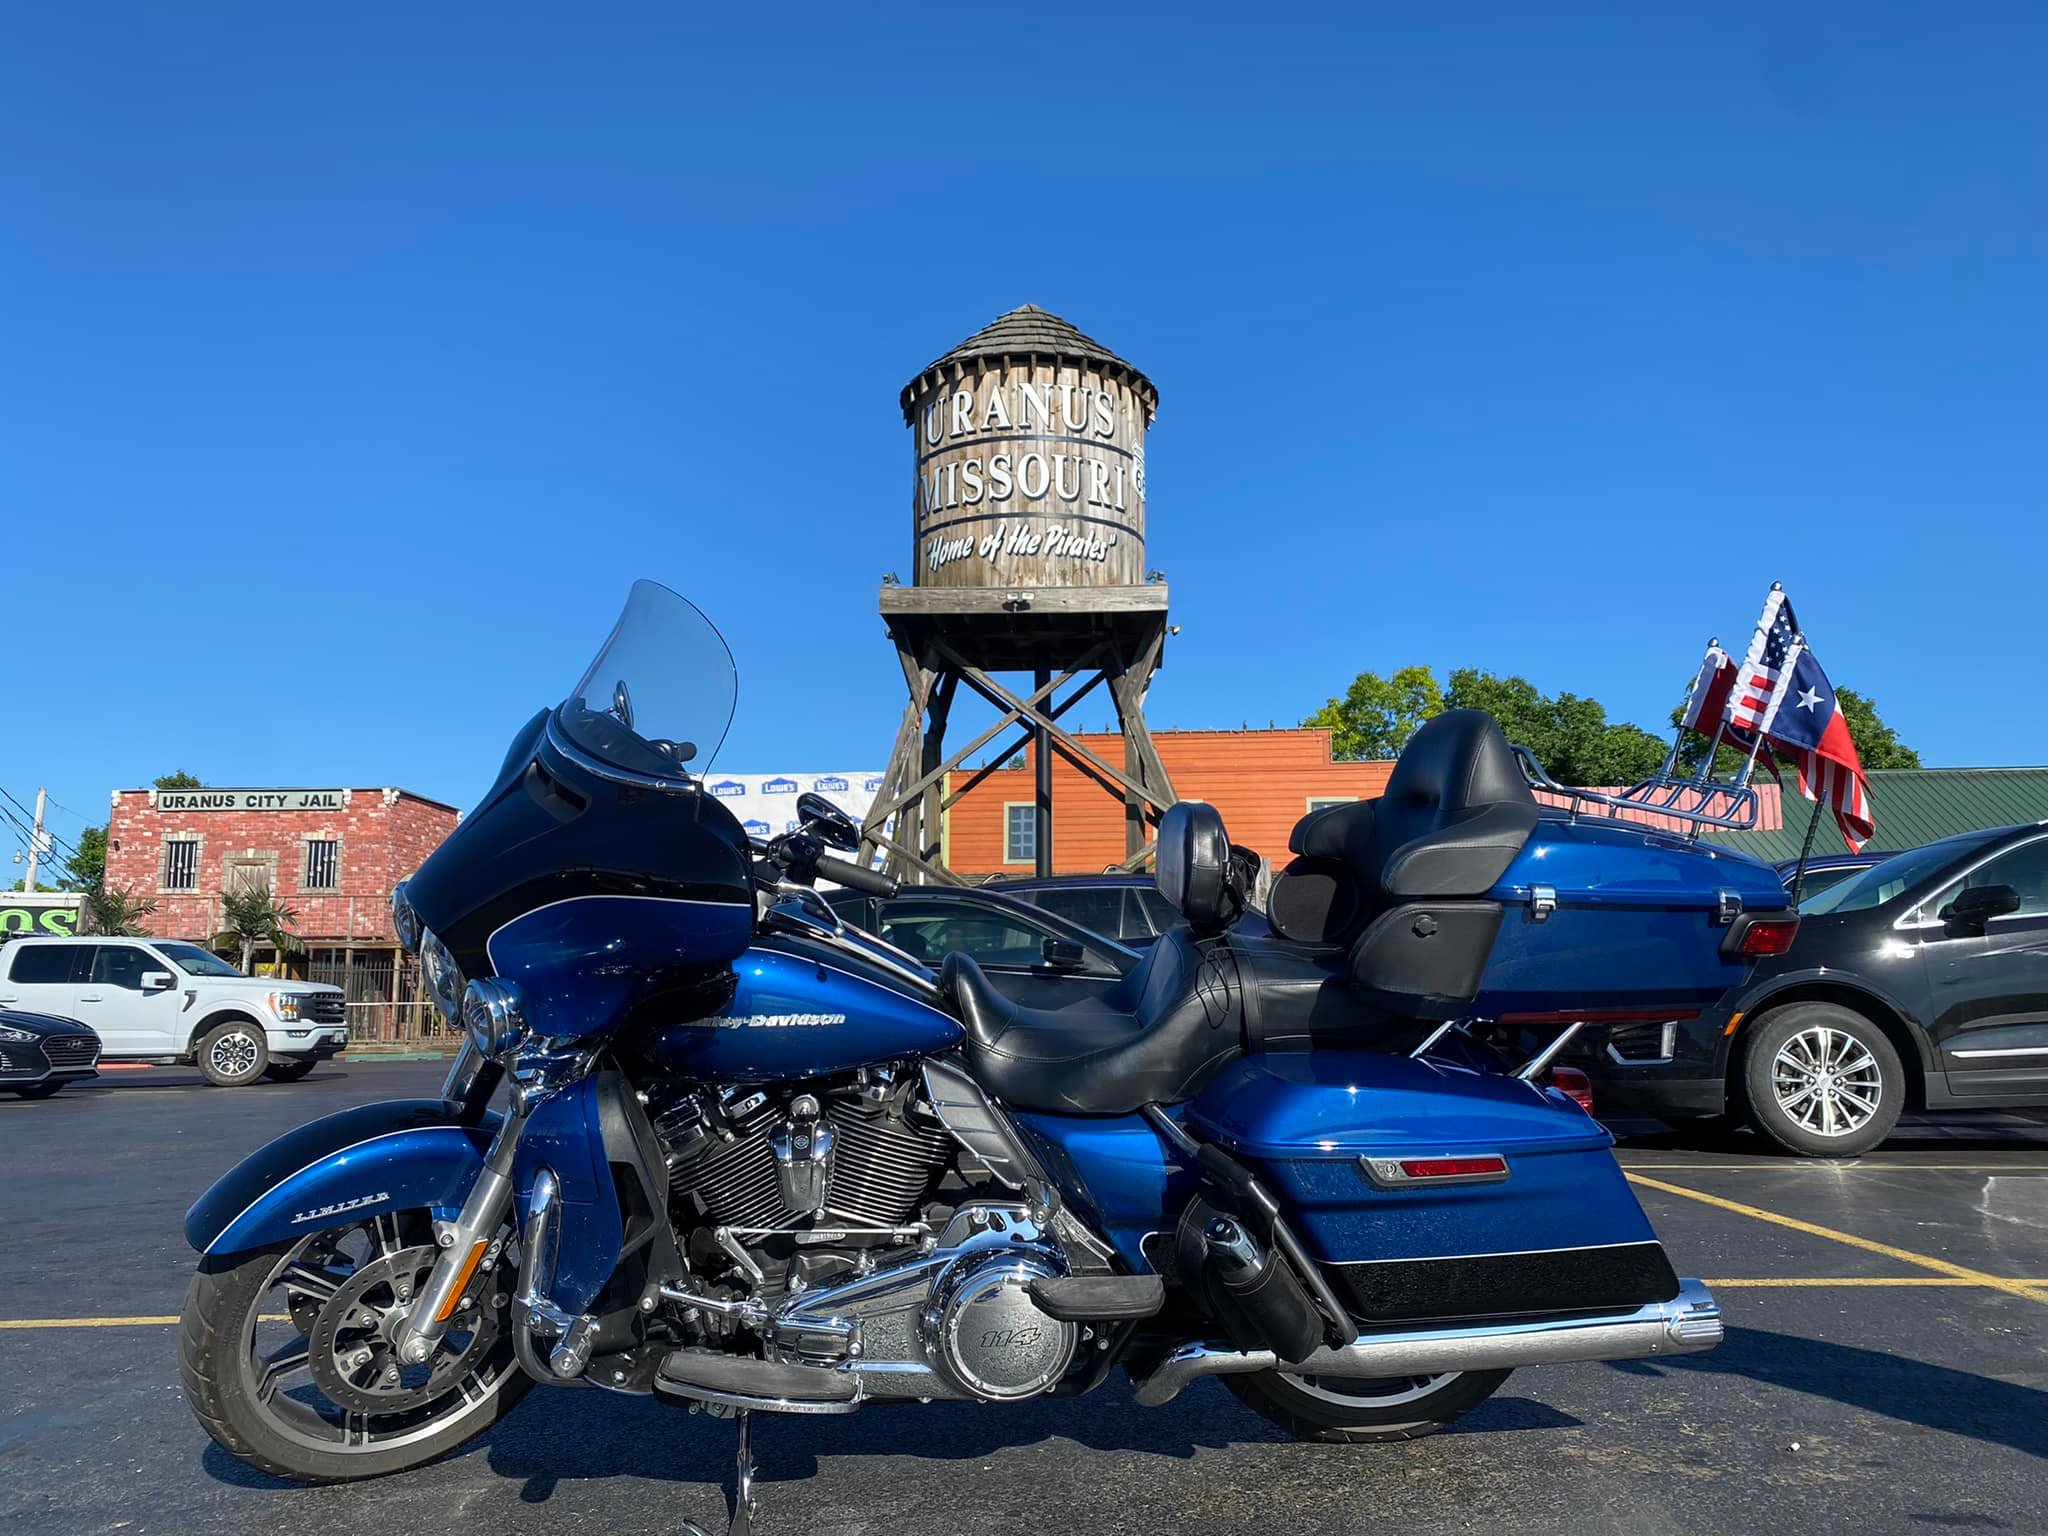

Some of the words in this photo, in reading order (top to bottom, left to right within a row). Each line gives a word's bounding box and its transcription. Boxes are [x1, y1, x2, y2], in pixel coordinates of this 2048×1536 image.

[925, 383, 1115, 445] URANUS
[920, 453, 1126, 519] MISSOURI
[979, 523, 1006, 563] of
[1007, 524, 1042, 555] the
[163, 795, 235, 808] URANUS
[246, 795, 287, 807] CITY
[299, 794, 337, 807] JAIL
[291, 1191, 391, 1223] LIMITED
[980, 1328, 1042, 1348] 114
